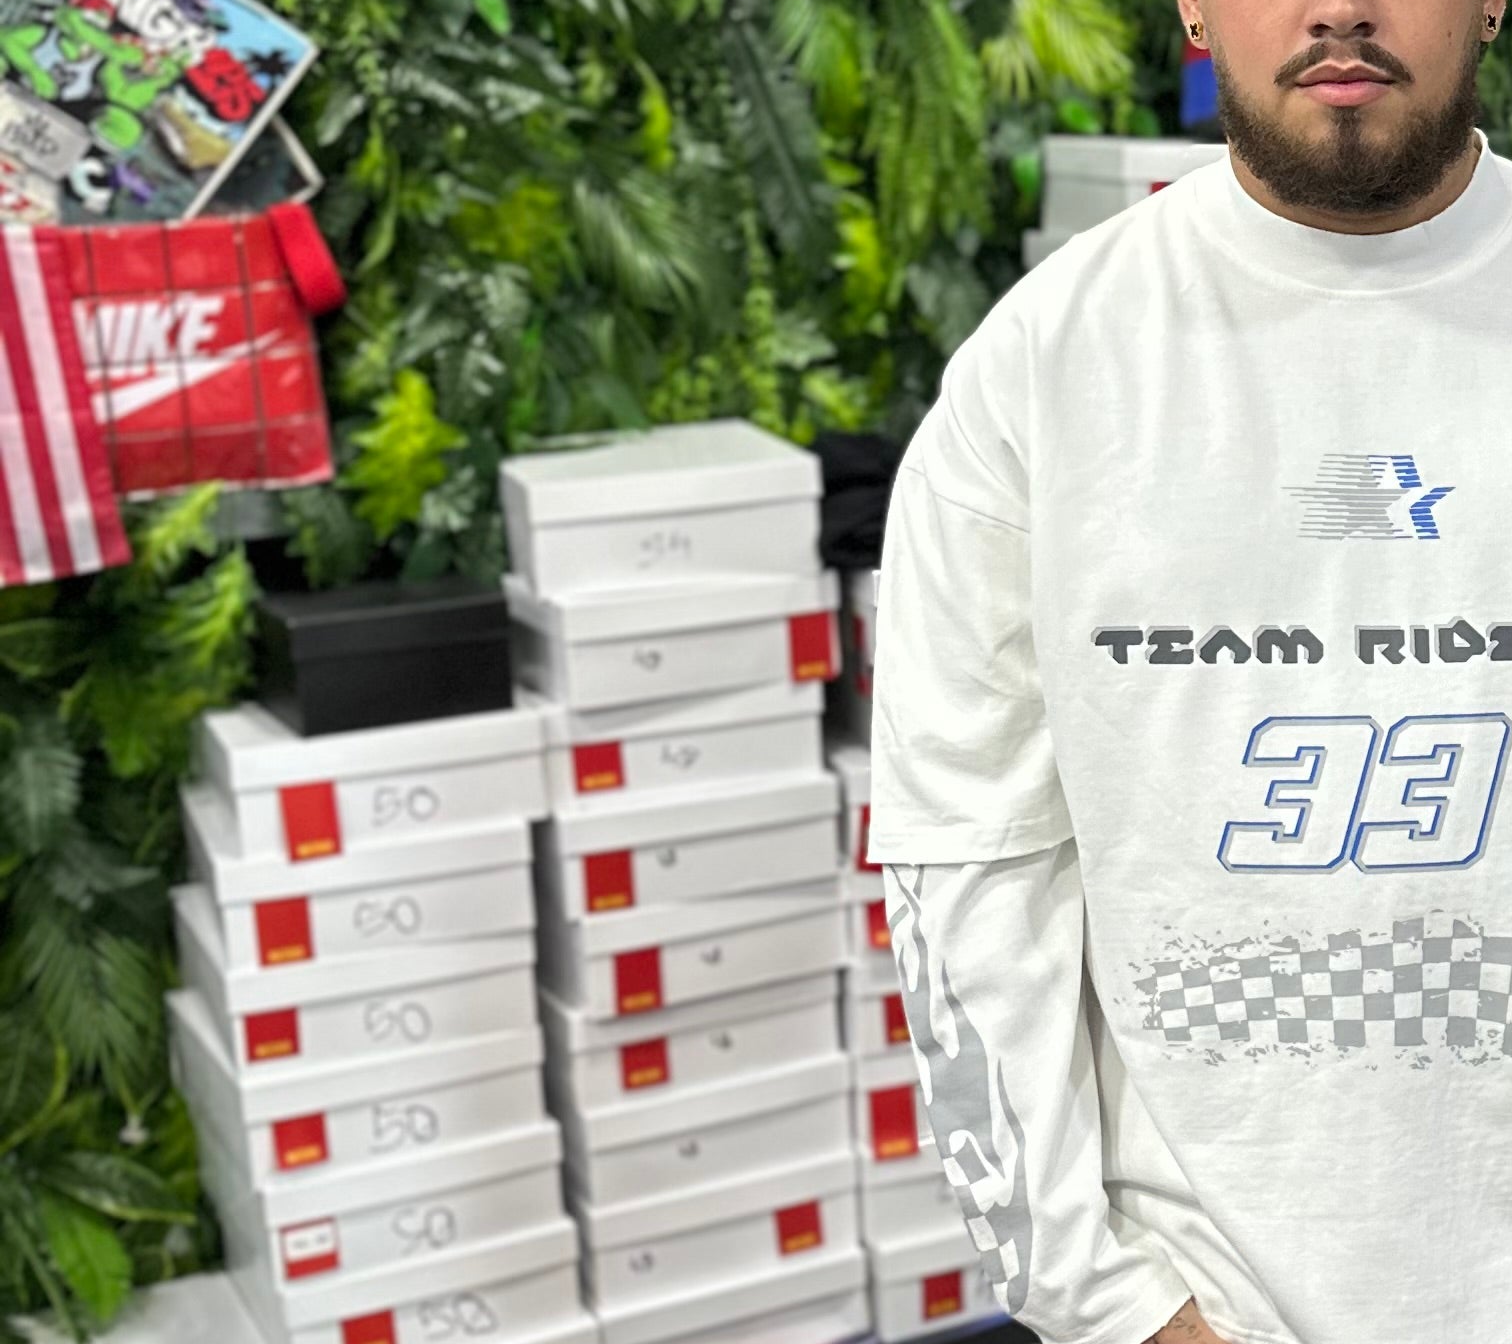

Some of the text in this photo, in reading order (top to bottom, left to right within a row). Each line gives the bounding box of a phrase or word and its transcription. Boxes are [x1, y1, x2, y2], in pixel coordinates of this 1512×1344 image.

[1091, 625, 1324, 664] TEAM
[371, 785, 440, 827] 50
[370, 1103, 438, 1153] 50
